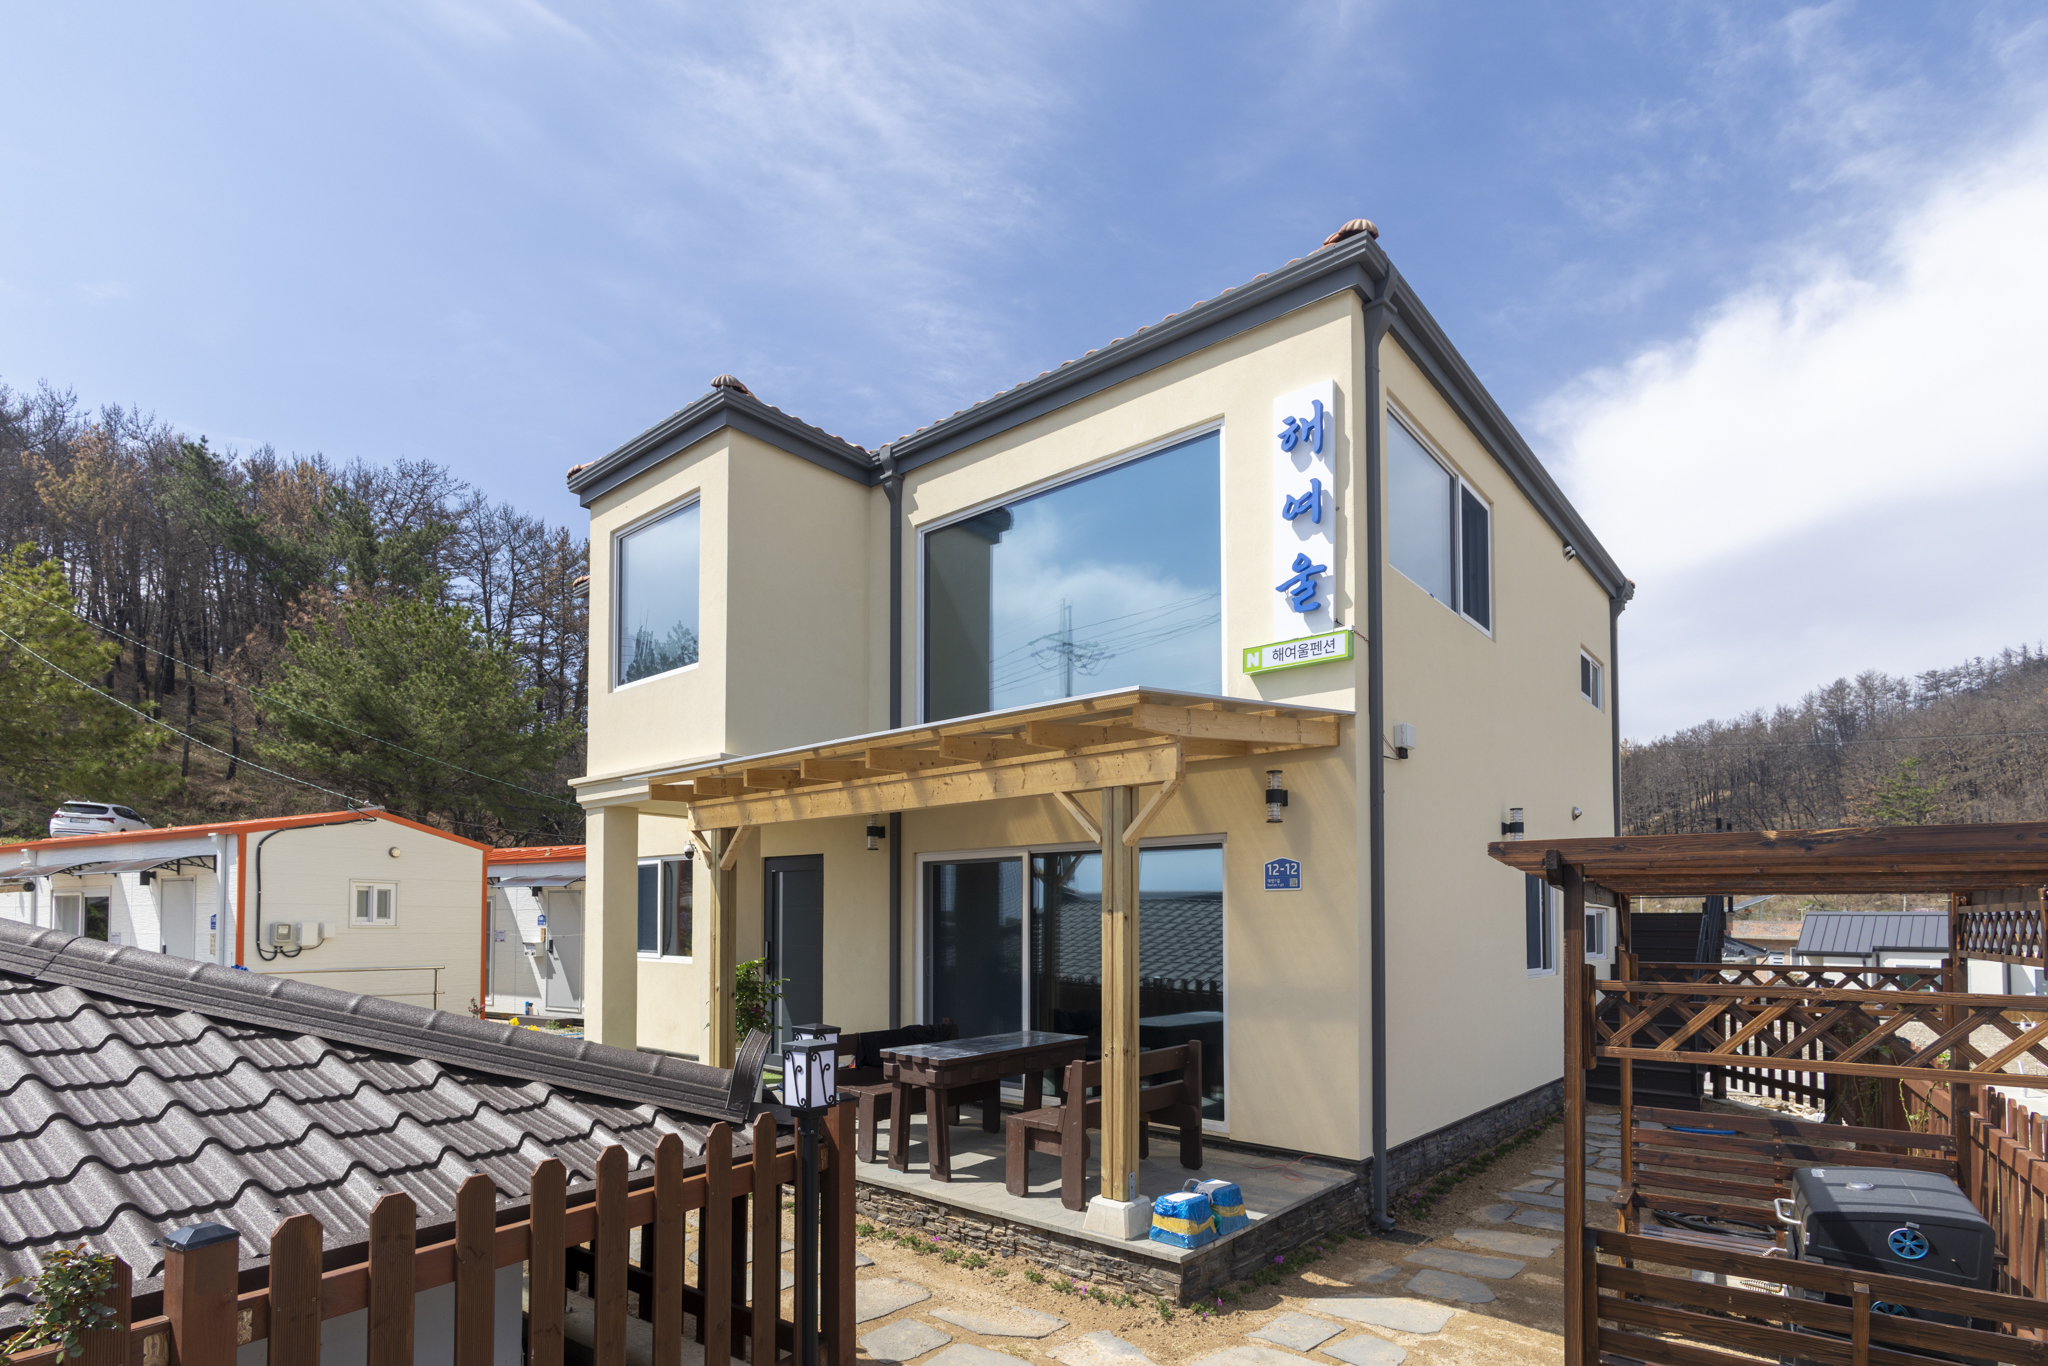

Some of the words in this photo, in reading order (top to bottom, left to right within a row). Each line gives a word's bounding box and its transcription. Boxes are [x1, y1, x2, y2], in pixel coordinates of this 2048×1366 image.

[1276, 398, 1328, 614] 해여울
[1246, 651, 1260, 669] N
[1271, 637, 1336, 662] 해여울펜션
[1267, 862, 1298, 876] 12-12
